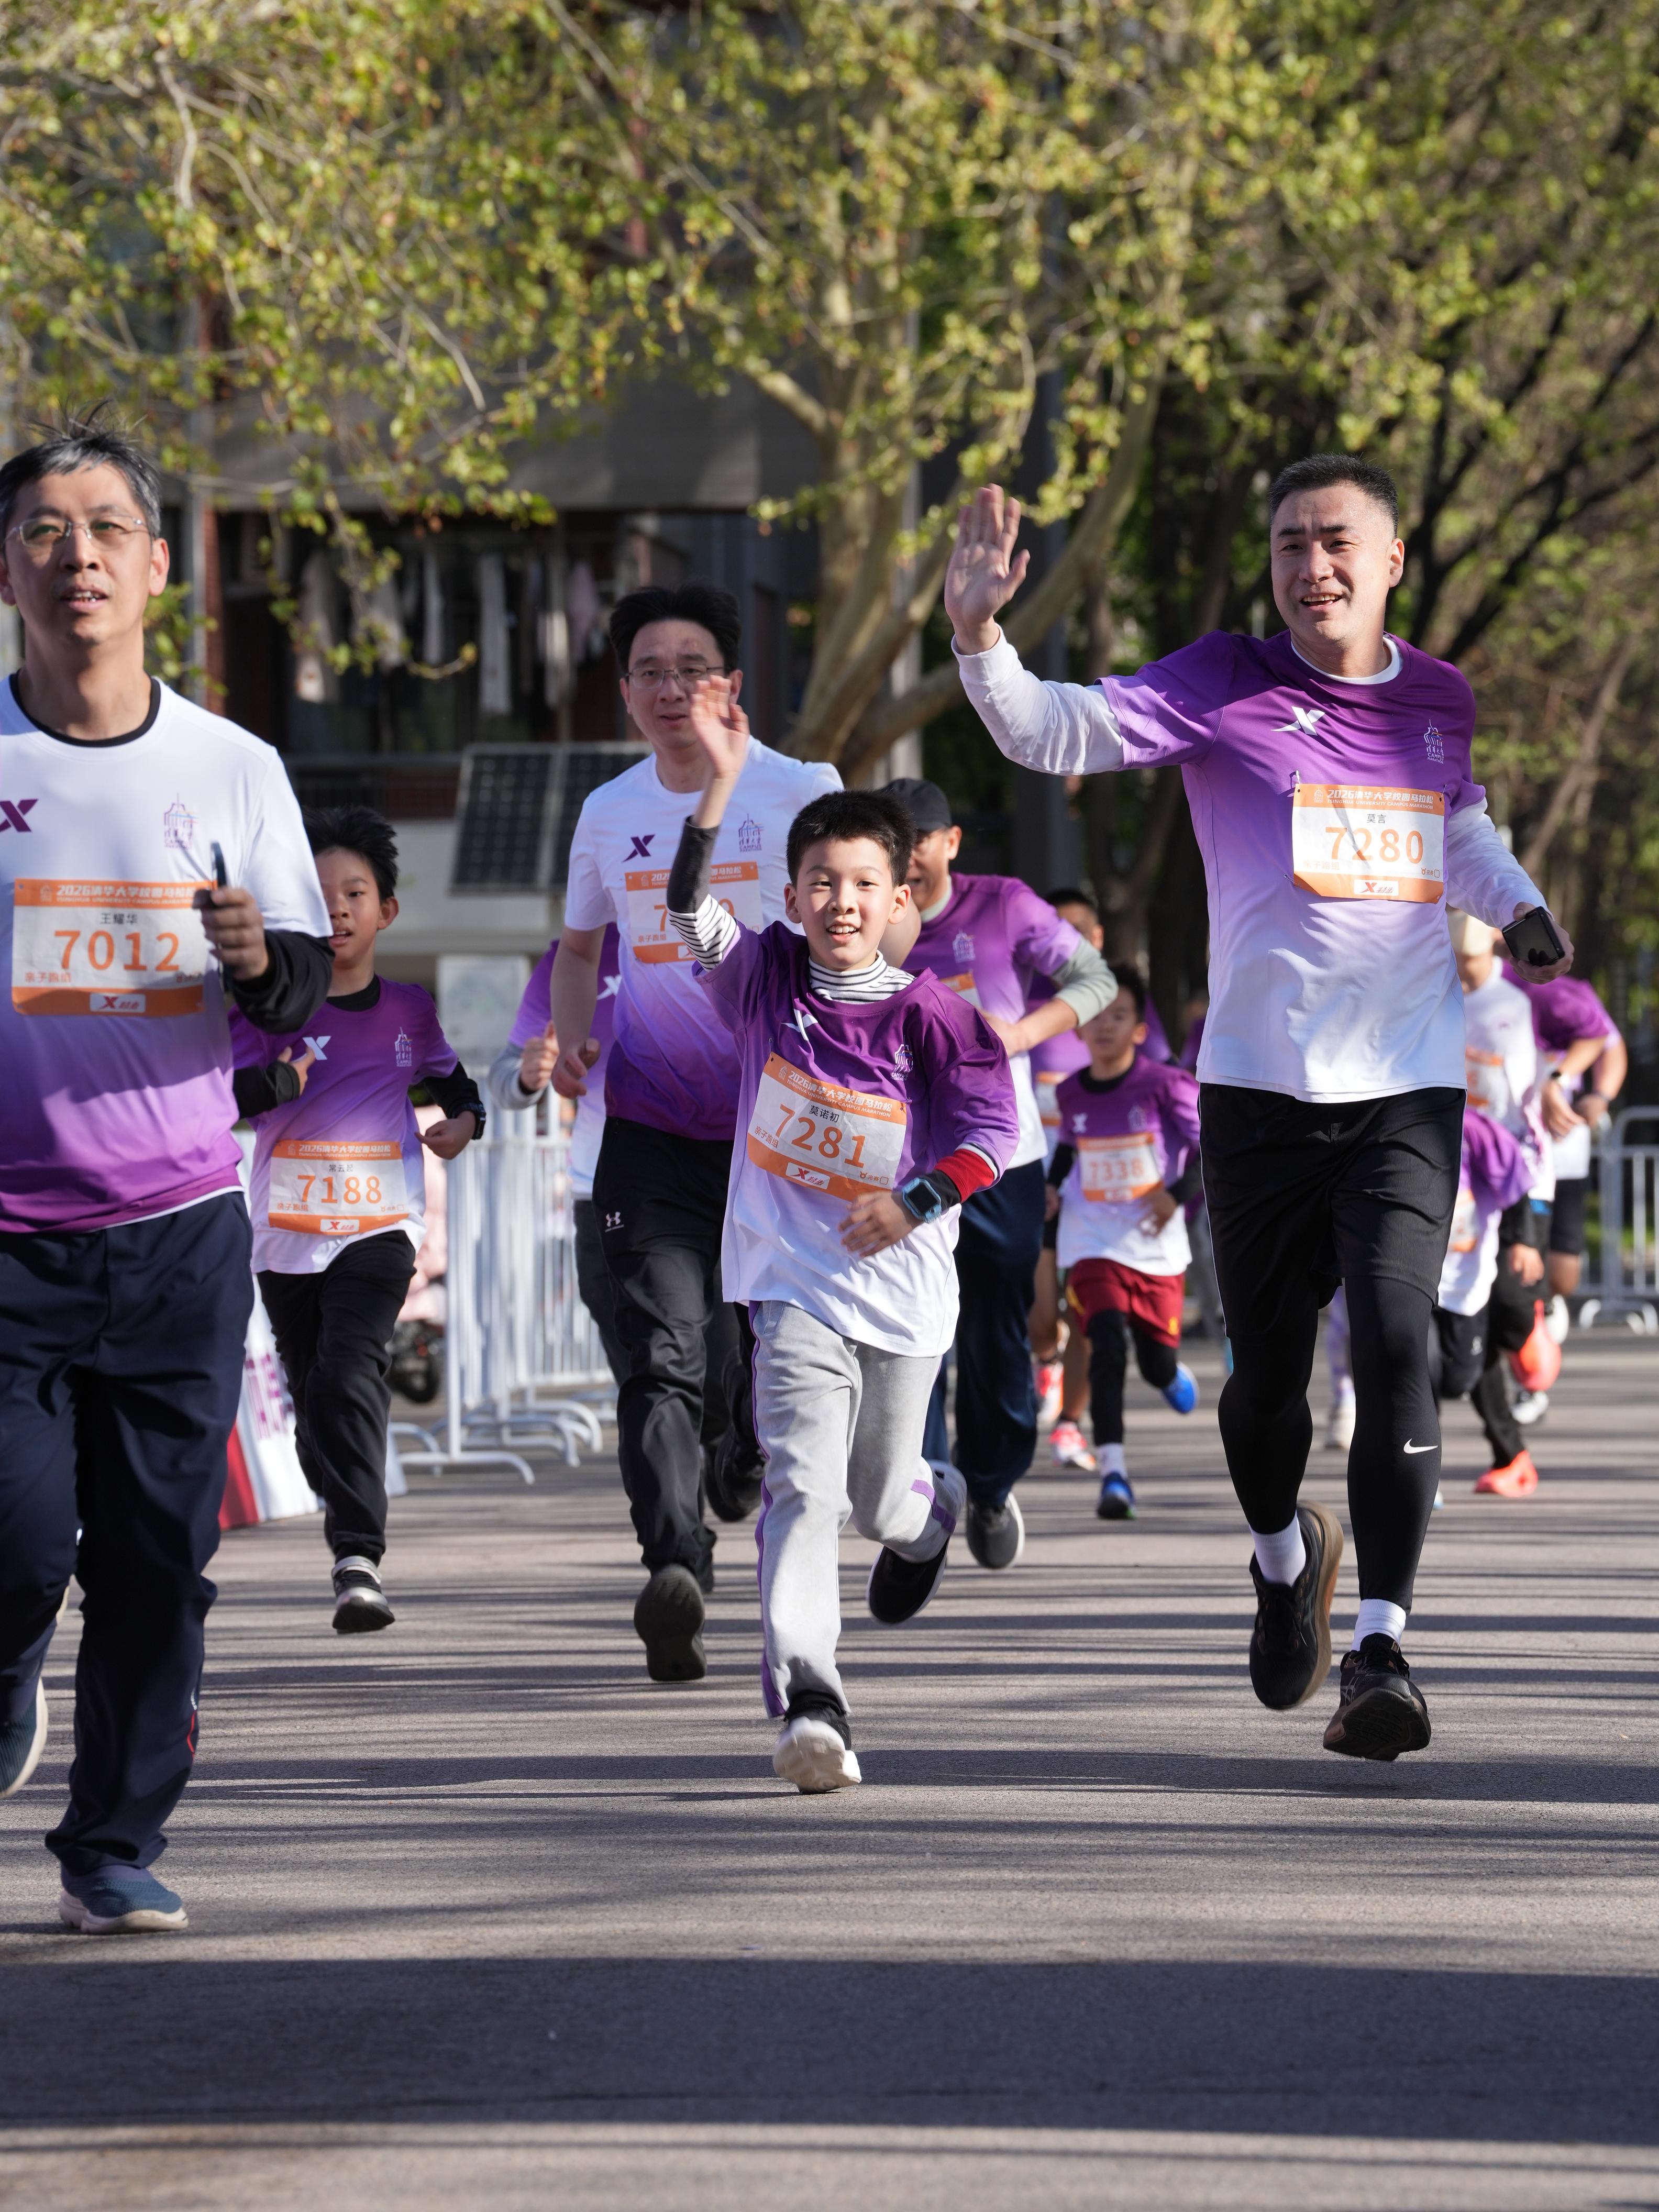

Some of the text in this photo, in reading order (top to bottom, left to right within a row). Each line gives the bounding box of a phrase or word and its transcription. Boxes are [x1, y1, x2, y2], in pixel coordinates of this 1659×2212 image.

[1428, 753, 1444, 761] CAMPUS
[1327, 790, 1433, 804] 2026清华大学校园马拉松
[1367, 814, 1386, 824] 莫言
[1325, 827, 1423, 864] 7280
[1303, 860, 1340, 870] 亲子跑组
[54, 930, 179, 972] 7012
[787, 1079, 891, 1118] TSINGHUA UNIVERSITY CAMPUS MARATHON
[788, 1070, 892, 1112] 2026清华大学校园马拉松
[809, 1104, 840, 1123] 莫诺初
[754, 1125, 779, 1148] 亲子跑组
[775, 1103, 865, 1168] 7281
[297, 1175, 382, 1204] 7188
